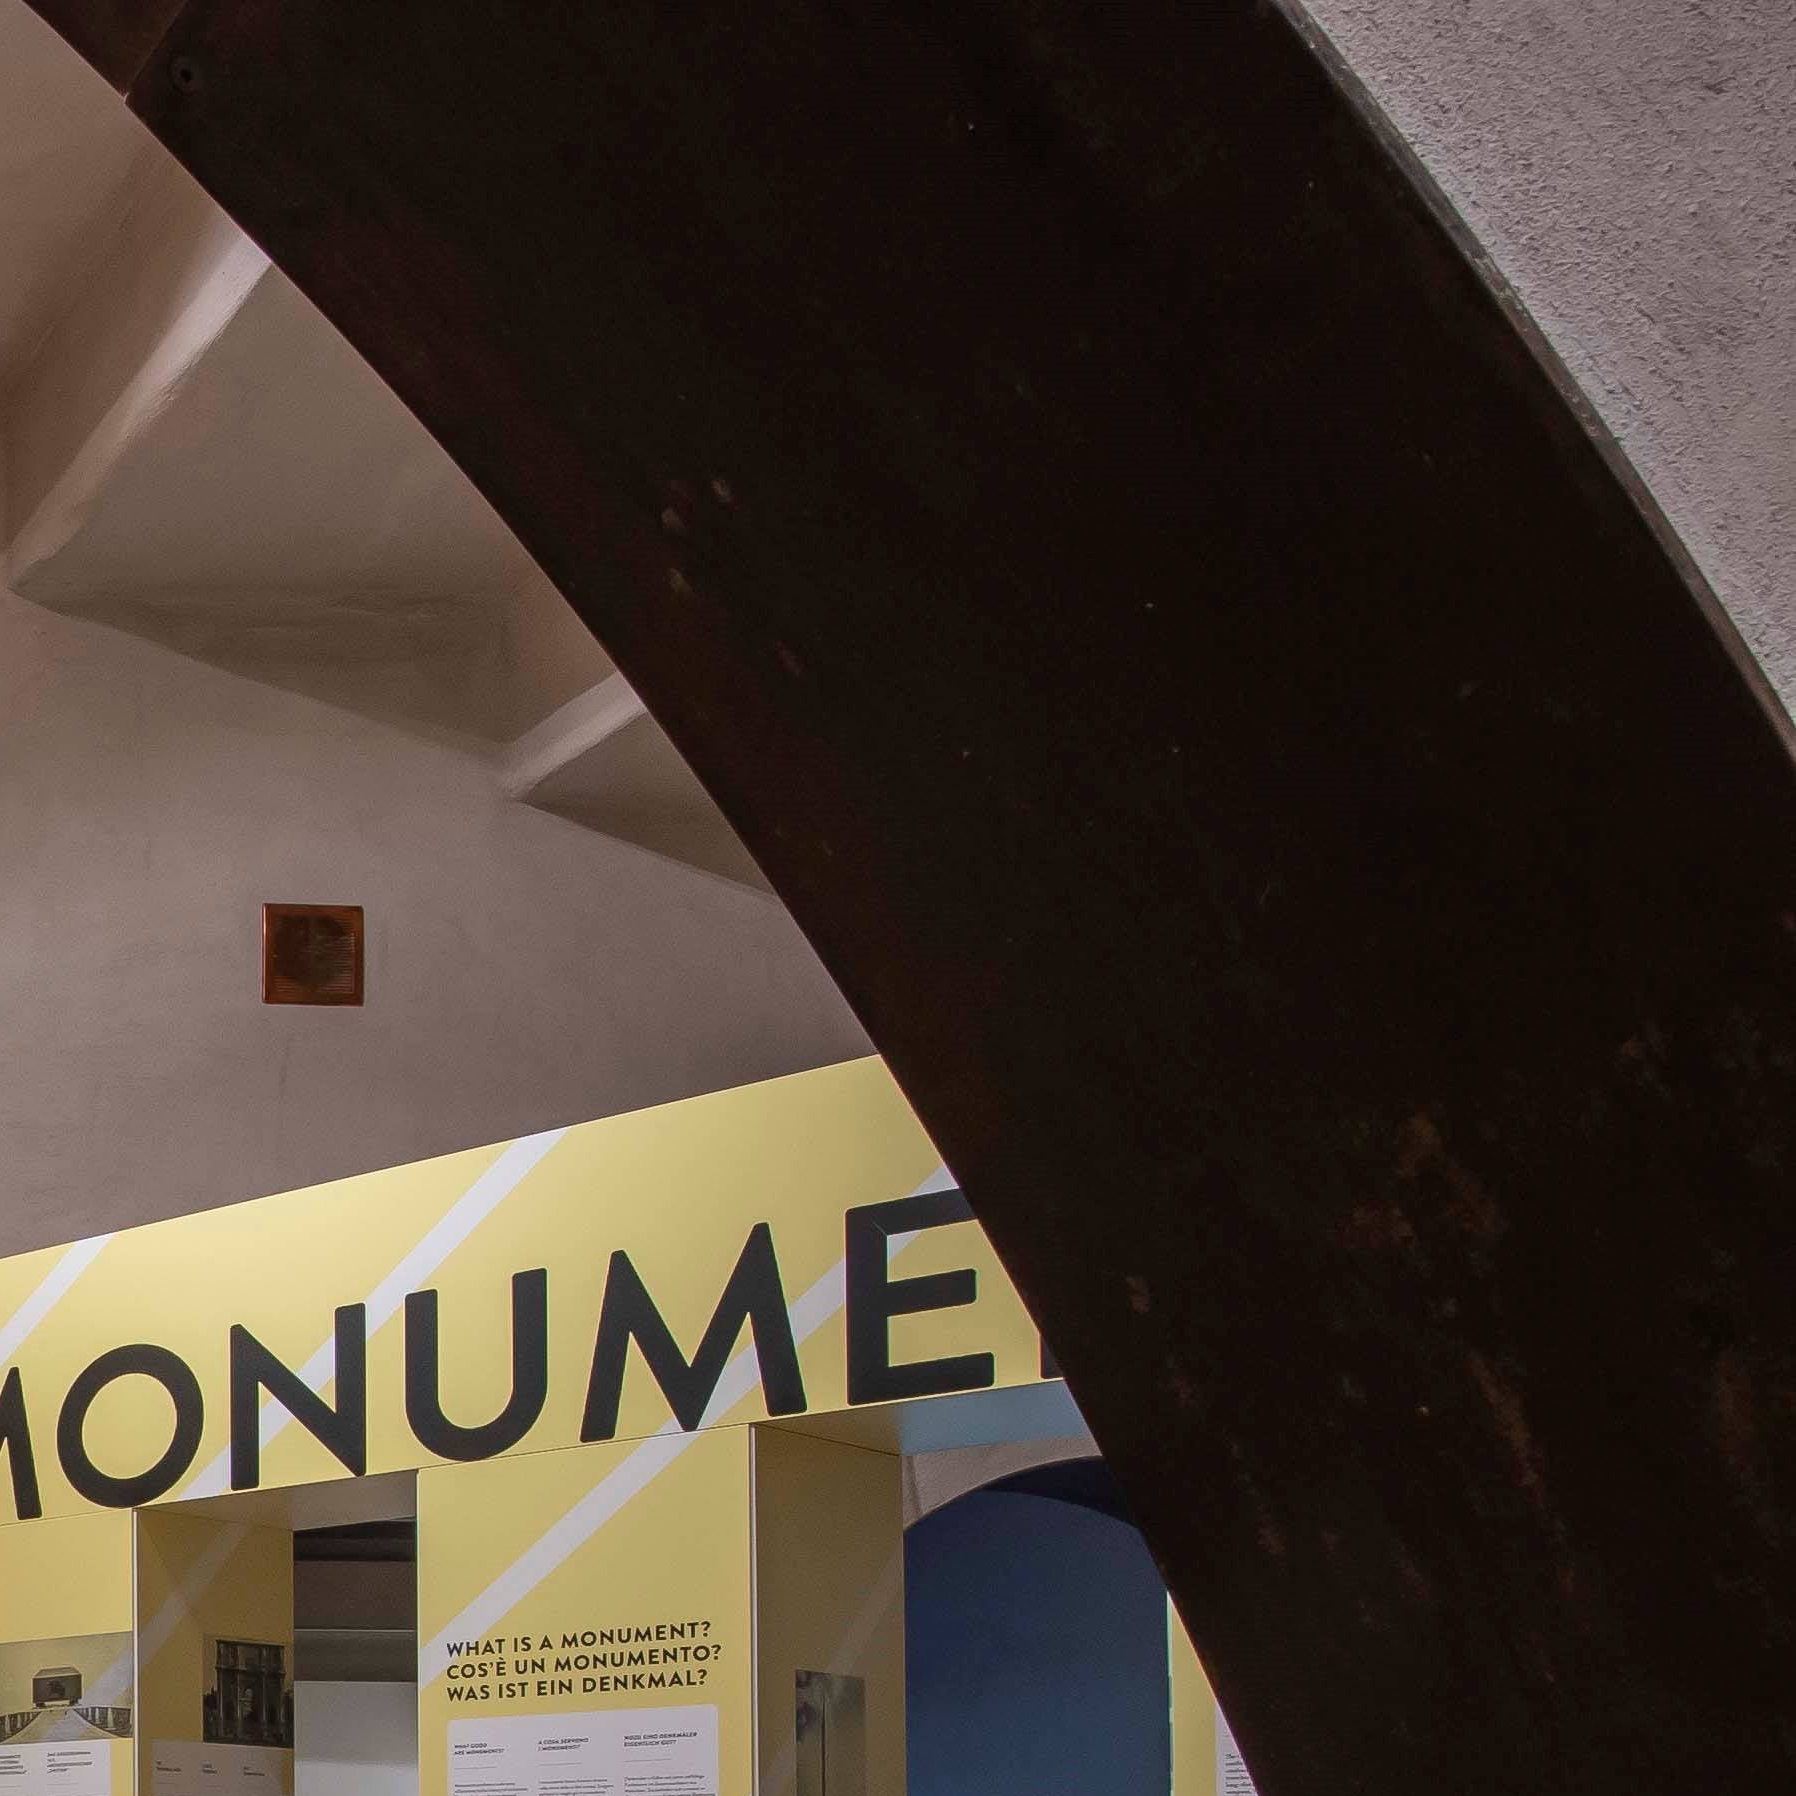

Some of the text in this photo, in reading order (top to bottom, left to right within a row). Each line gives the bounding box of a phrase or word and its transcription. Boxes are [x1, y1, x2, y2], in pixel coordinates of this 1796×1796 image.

[447, 1620, 711, 1658] WHAT IS A MONUMENT?
[515, 1658, 547, 1675] UN
[554, 1644, 722, 1673] MONUMENTO?
[447, 1668, 708, 1702] WAS IST EIN DENKMAL?
